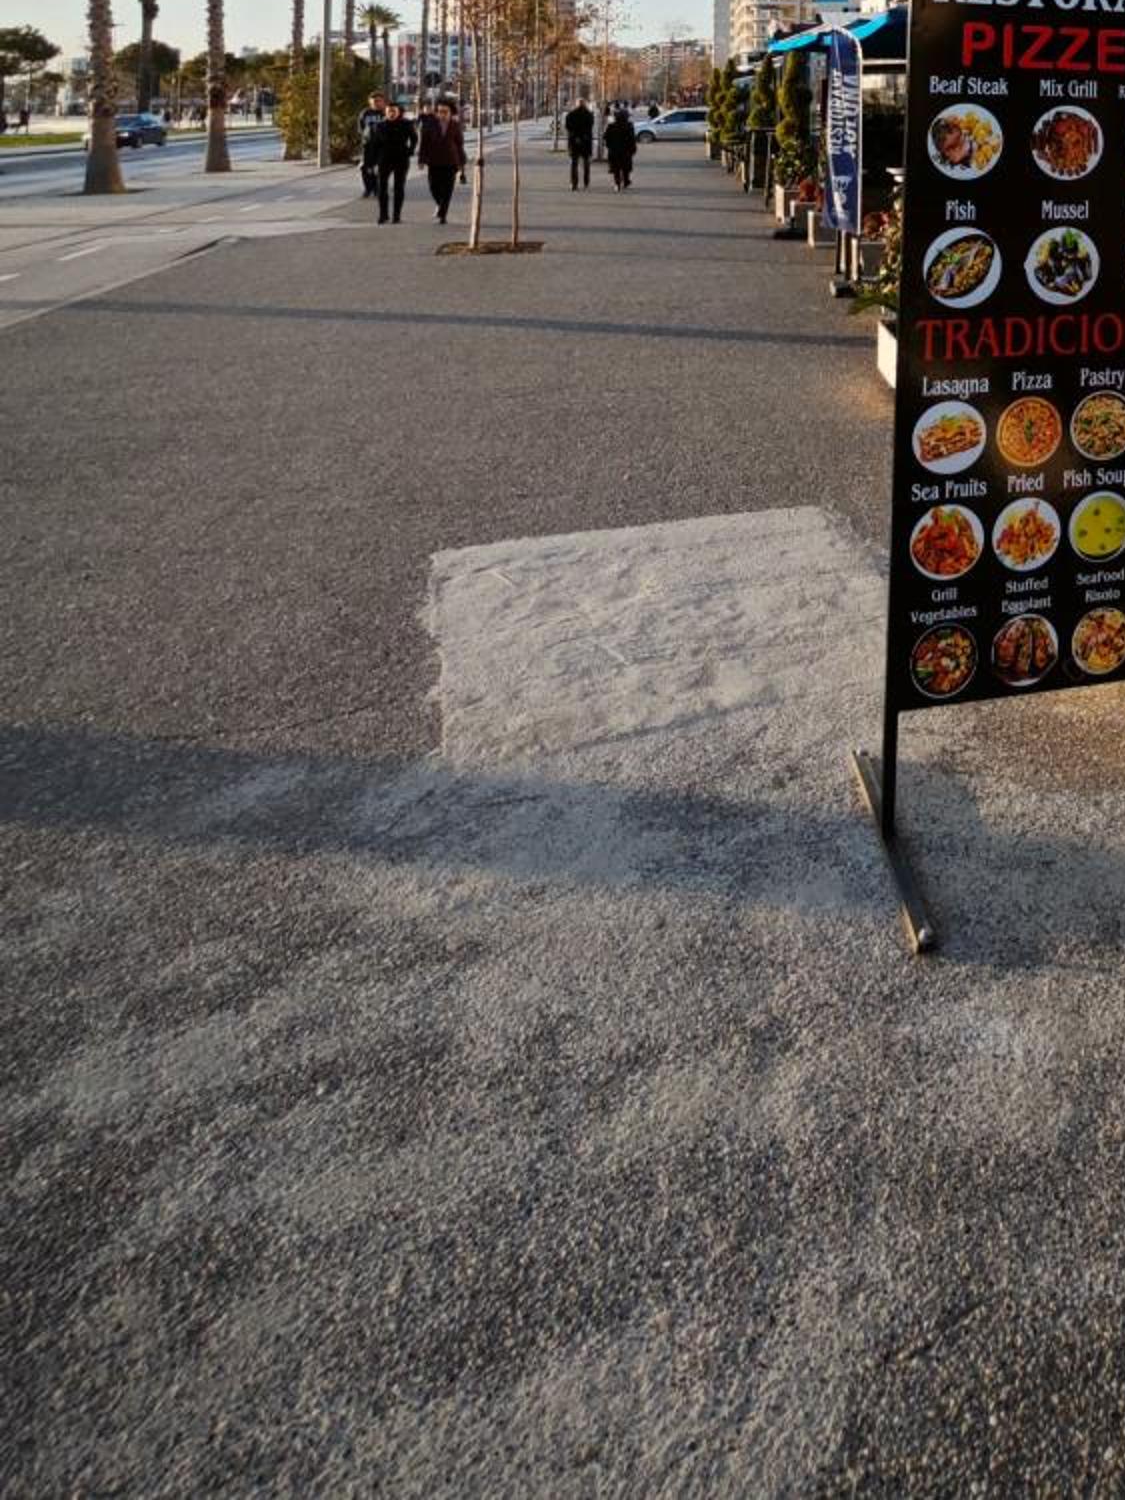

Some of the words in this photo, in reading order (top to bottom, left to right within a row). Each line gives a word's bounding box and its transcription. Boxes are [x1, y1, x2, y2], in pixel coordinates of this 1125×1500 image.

[929, 75, 964, 93] Beaf
[967, 77, 1008, 95] Steak
[1039, 79, 1066, 97] Mix
[1067, 80, 1097, 97] Grill
[945, 200, 976, 220] Fish
[1041, 200, 1088, 219] Mussel
[922, 376, 989, 399] Lasagna
[1012, 371, 1052, 390] Pizza
[1080, 367, 1125, 390] Pastry
[1007, 473, 1044, 493] Fried
[1063, 470, 1092, 489] Fish
[911, 484, 939, 501] Sea
[945, 478, 987, 499] Fruits
[931, 587, 957, 602] Grill
[1005, 577, 1049, 594] Stuffed
[1001, 596, 1051, 615] Eggplant
[910, 606, 977, 625] Vegetables
